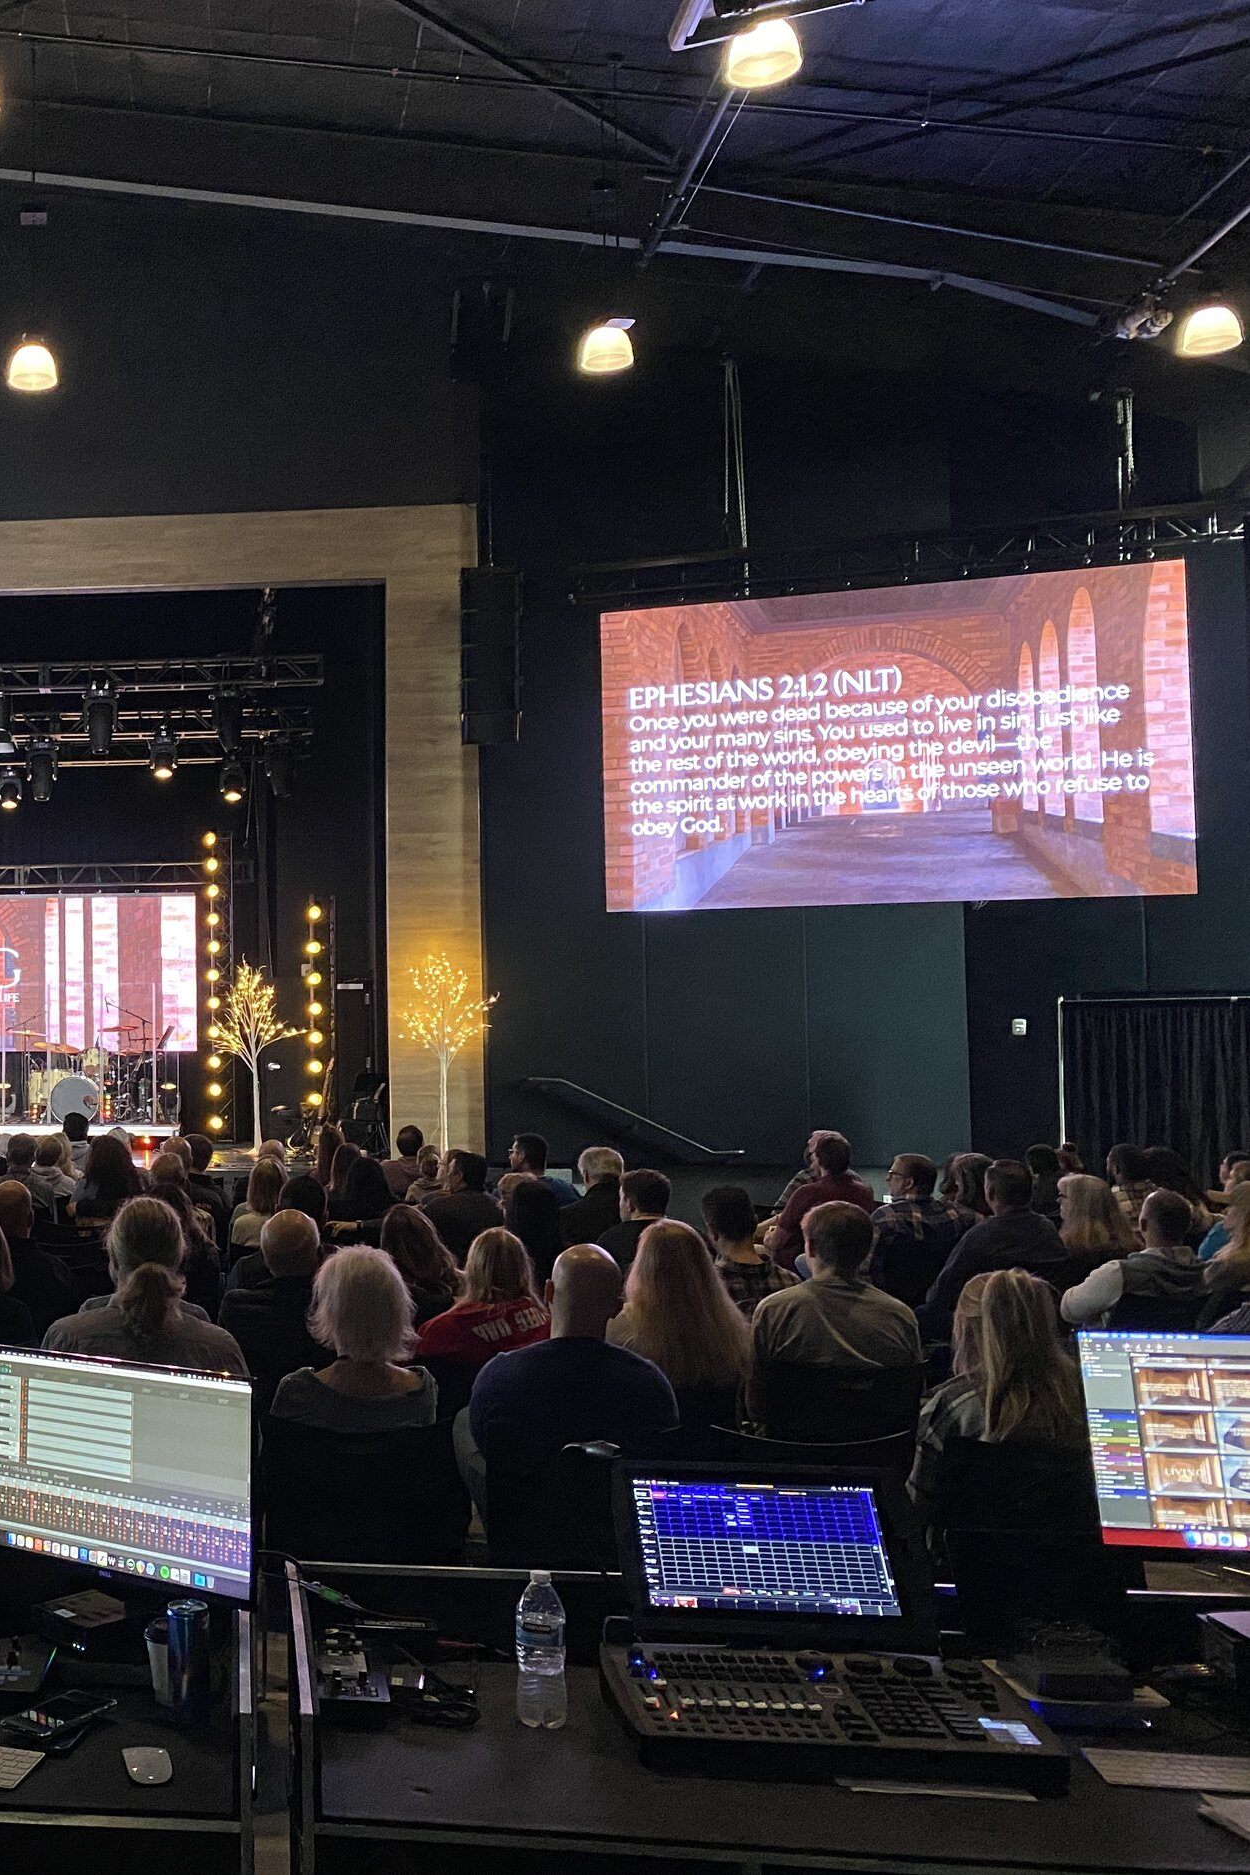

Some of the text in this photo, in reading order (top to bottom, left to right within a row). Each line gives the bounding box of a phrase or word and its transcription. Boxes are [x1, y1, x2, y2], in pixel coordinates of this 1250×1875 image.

[629, 665, 902, 709] EPHESIANS 2:1,2 (NLT)
[629, 684, 1130, 732] Once you were dead because of your disobedience
[630, 736, 666, 752] and
[669, 734, 712, 752] your
[716, 731, 771, 748] many
[774, 727, 815, 743] sins.
[818, 724, 854, 740] You
[860, 718, 908, 738] used
[912, 718, 934, 734] to
[938, 716, 972, 733] live
[977, 713, 996, 730] in
[1037, 708, 1078, 730] just
[1083, 707, 1121, 724] like
[630, 756, 662, 774] the
[666, 754, 702, 772] rest
[704, 752, 726, 769] of
[726, 750, 759, 768] the
[762, 746, 821, 766] world,
[825, 743, 904, 762] obeying
[908, 739, 944, 756] the
[631, 774, 749, 795] commander
[752, 770, 774, 788] of
[774, 768, 807, 786] the
[812, 766, 883, 786] powers
[888, 762, 906, 780] in
[910, 760, 946, 779] the
[950, 759, 1026, 777] unseen
[1102, 750, 1134, 768] He
[1138, 747, 1156, 766] is
[631, 774, 1150, 816] the spirit at work in the hearts of those who refuse to
[631, 816, 724, 838] obey God.
[0, 993, 20, 1002] LIFE
